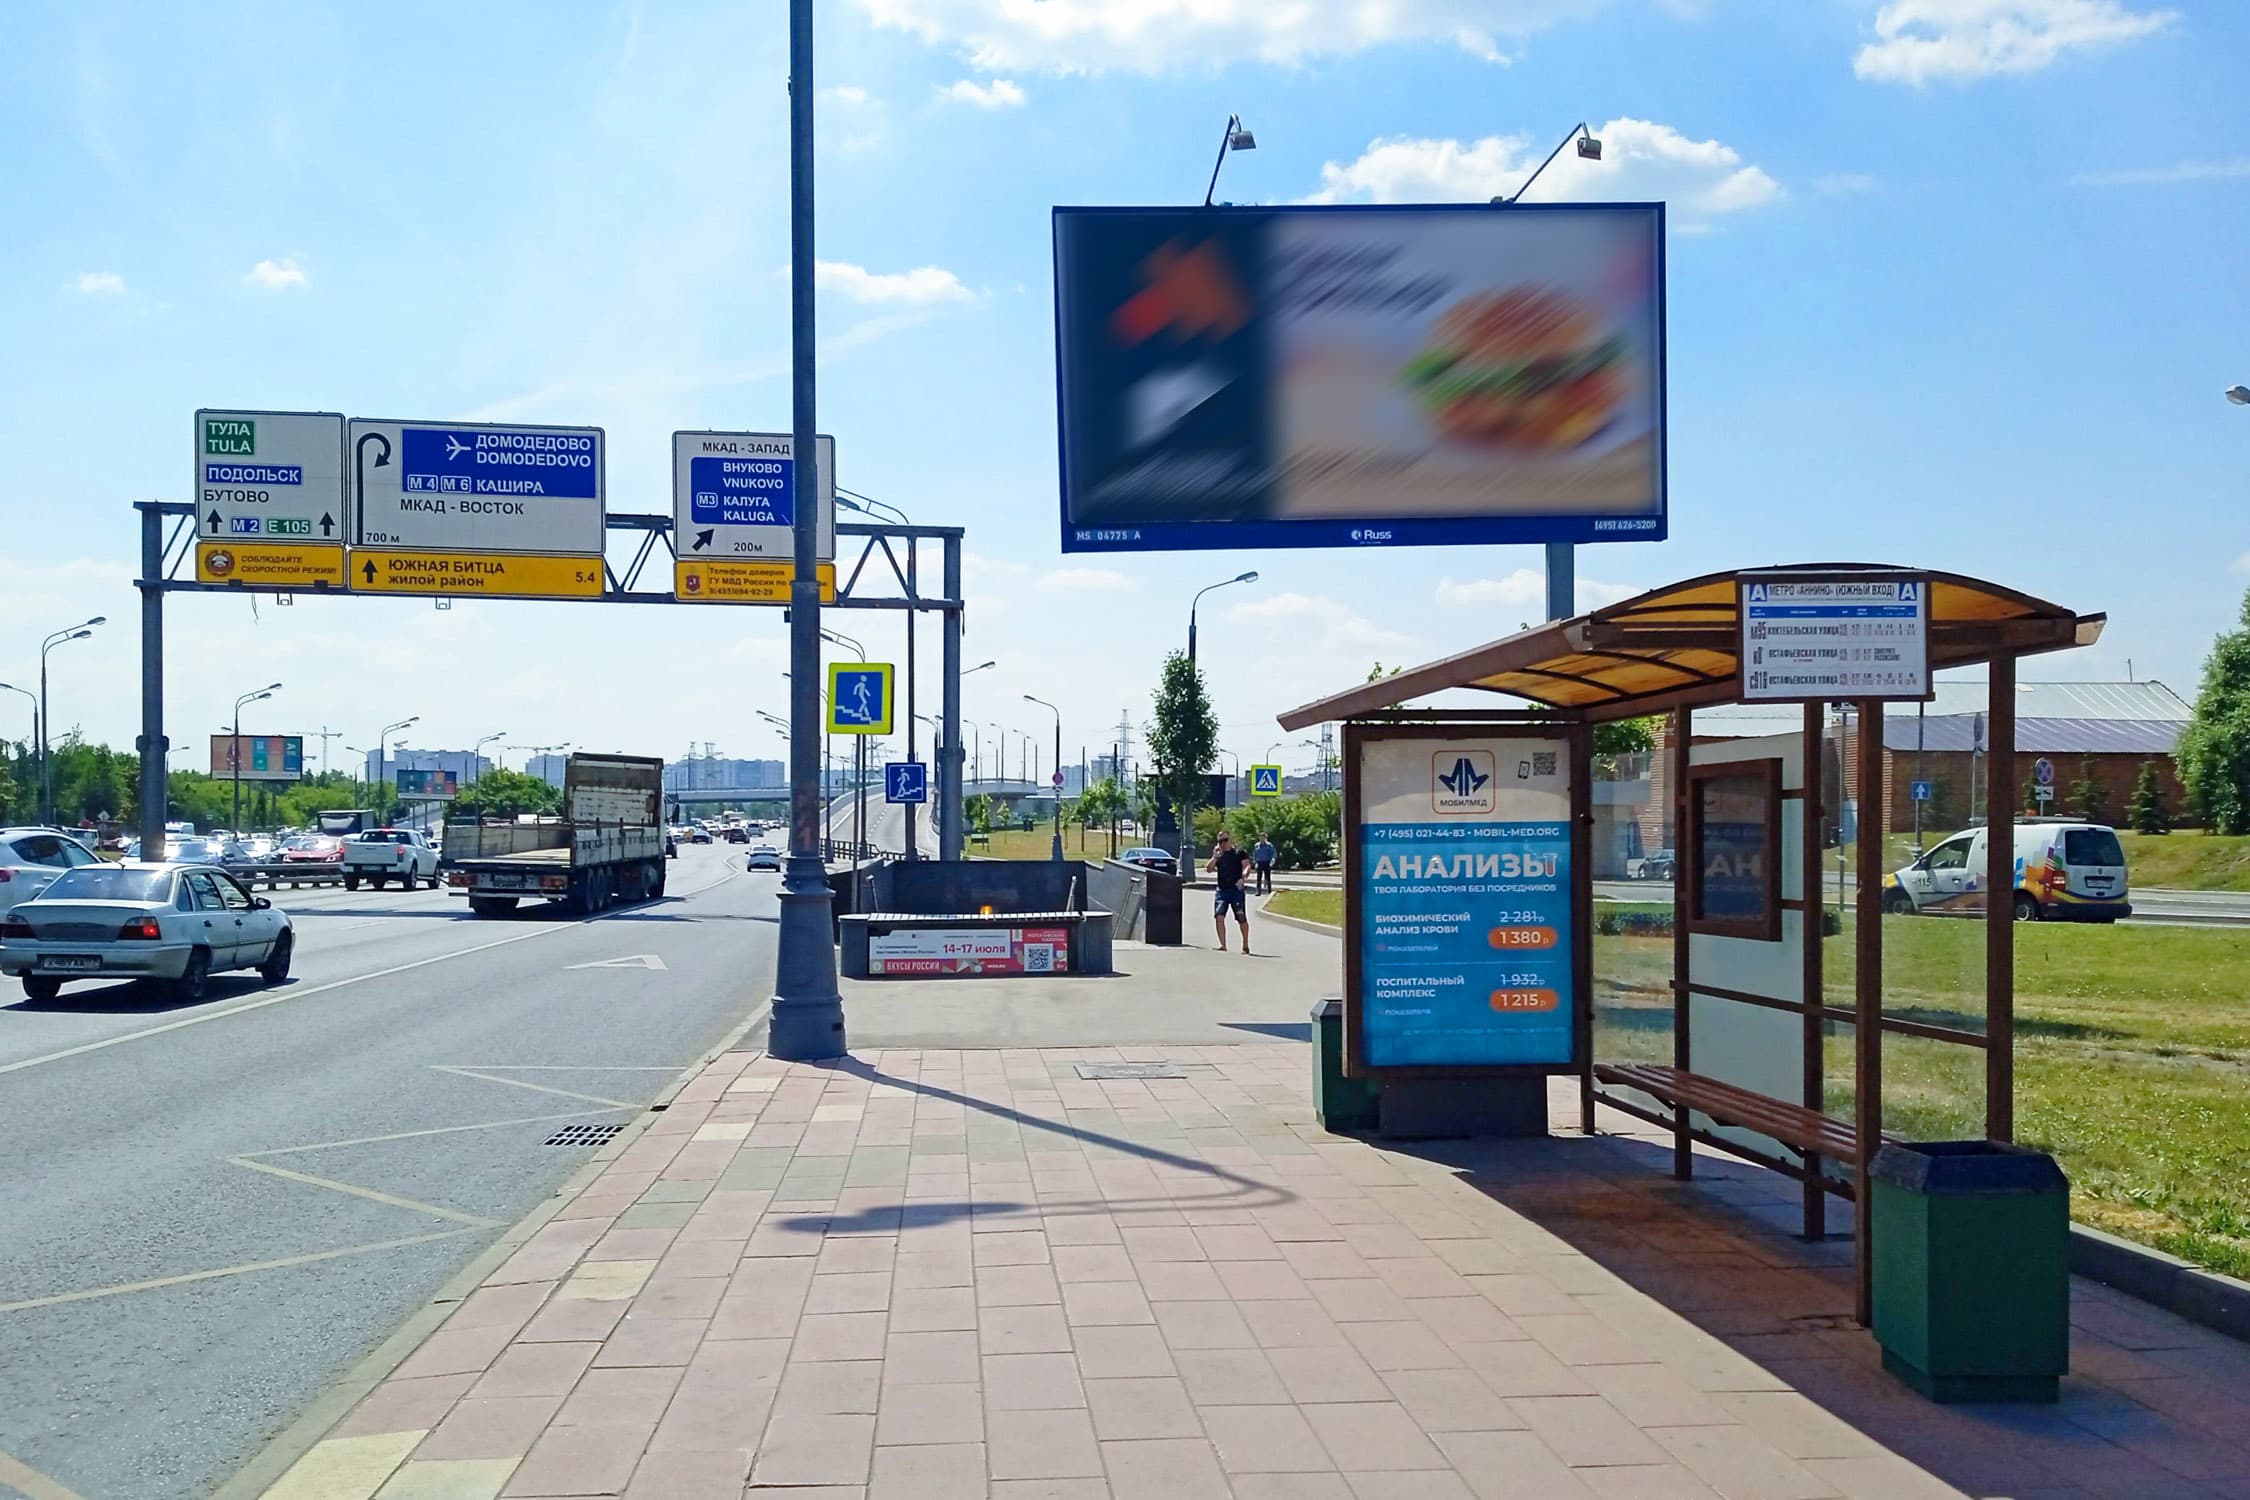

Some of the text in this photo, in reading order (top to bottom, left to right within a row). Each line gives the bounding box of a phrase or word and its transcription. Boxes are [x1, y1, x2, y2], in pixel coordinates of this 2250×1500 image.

[208, 422, 251, 436] ТУЛА
[208, 439, 252, 453] TULA
[476, 434, 591, 452] ДОМОДЕДОВО
[702, 442, 738, 454] МКАД
[749, 443, 791, 455] ЗАПАД
[476, 451, 592, 468] DOMODEDOVO
[723, 462, 782, 474] ВНУКОВО
[208, 467, 299, 483] ПОДОЛЬСК
[476, 480, 544, 494] КАШИРА
[723, 478, 784, 489] VNUKOVO
[204, 489, 269, 503] БУТОВО
[699, 495, 716, 506] М3
[723, 496, 771, 508] КАЛУГА
[400, 499, 446, 514] МКАД
[461, 501, 524, 515] ВОСТОК
[723, 511, 775, 522] KALUGA
[366, 532, 387, 543] 700
[1097, 530, 1128, 541] 04775
[1364, 529, 1392, 540] Russ
[241, 555, 303, 564] СОБЛЮДАЙТЕ
[241, 565, 300, 574] СКОРОСТНОЙ
[388, 559, 505, 575] ЮЖНАЯ БИТЦА
[709, 567, 747, 575] Телефон
[388, 574, 484, 588] жилой район
[575, 571, 595, 583] 5.4
[1769, 585, 1794, 596] МЕТРО
[1872, 584, 1895, 597] ВХОД)
[1440, 799, 1488, 807] МОБИЛМЕД
[1374, 829, 1386, 838] +7
[1388, 828, 1413, 839] (495)
[1474, 828, 1560, 837] MOBIL-MED.ORG
[1374, 886, 1398, 894] ТВОЯ
[1400, 885, 1466, 894] ЛАБОРАТОРИЯ
[1487, 884, 1557, 892] ПОСРЕДНИКОВ
[1376, 911, 1471, 923] БИОХИМИЧЕСКИЙ
[1376, 925, 1458, 935] АНАЛИЗ КРОВИ
[975, 944, 1006, 954] июля
[887, 961, 940, 970] ВКУСЫ РОССИИ
[1376, 975, 1465, 987] ГОСПИТАЛЬНЫЙ
[1376, 989, 1436, 998] КОМПЛЕКС
